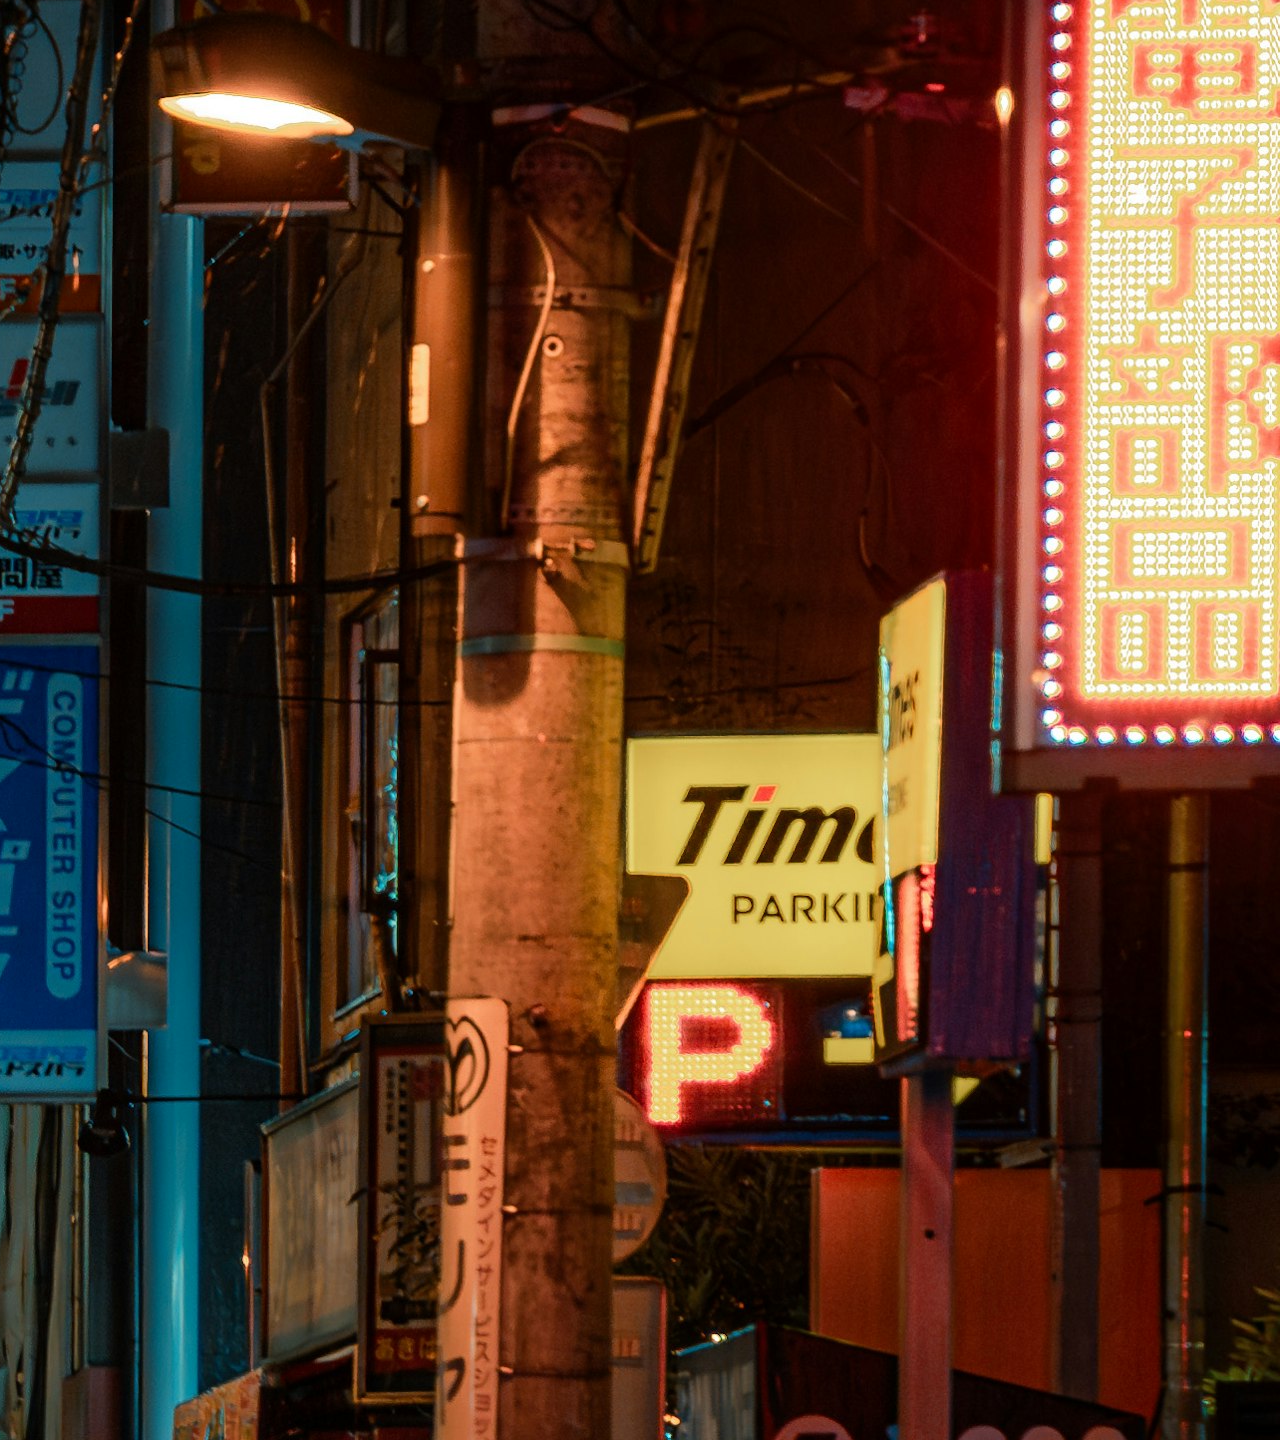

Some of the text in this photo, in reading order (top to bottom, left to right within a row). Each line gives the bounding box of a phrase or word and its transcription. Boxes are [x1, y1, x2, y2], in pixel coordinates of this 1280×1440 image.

[52, 690, 78, 982] COMPUTER SHOP
[730, 891, 877, 924] PARKI
[646, 985, 773, 1125] P
